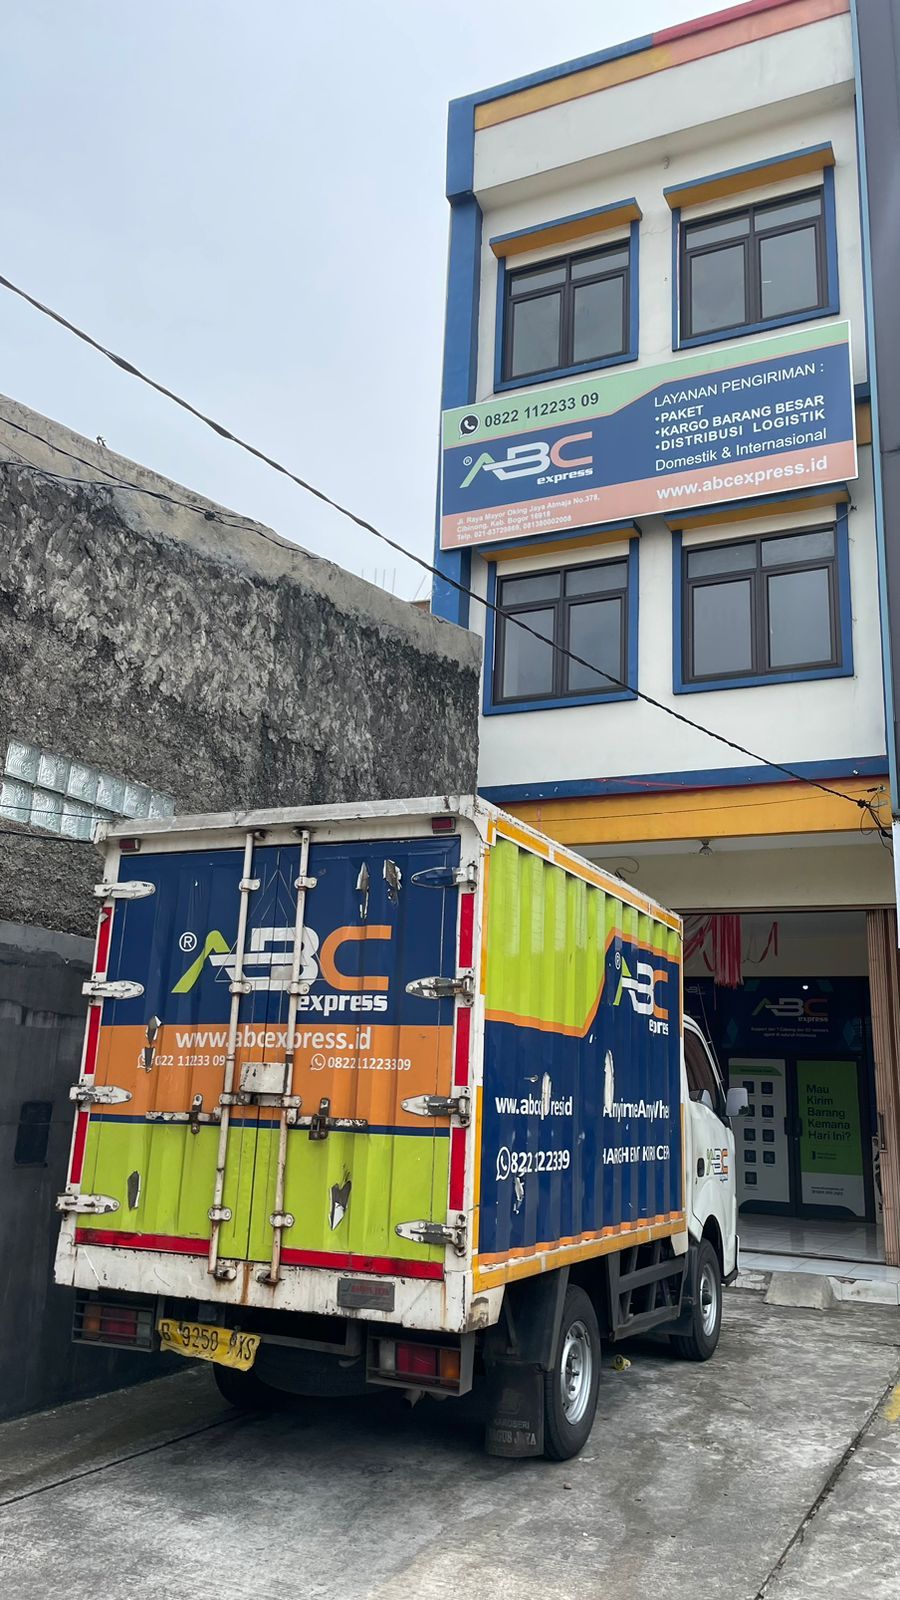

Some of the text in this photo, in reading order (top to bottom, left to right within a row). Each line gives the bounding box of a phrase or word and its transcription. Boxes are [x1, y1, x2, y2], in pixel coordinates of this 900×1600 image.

[654, 384, 718, 408] LAYANAN
[722, 362, 815, 394] PENGIRIMAN
[484, 392, 599, 428] 0822 112233 09
[660, 395, 825, 437] KARGO BARANG BESAR
[661, 404, 704, 423] PAKET
[661, 408, 826, 451] DISTRIBUSI LOGISTIK
[460, 431, 593, 489] ABC
[656, 428, 827, 472] Domestik & Internasional
[536, 468, 594, 486] express
[656, 456, 828, 500] www.abcexpress.id
[484, 511, 506, 522] Mayor
[529, 504, 546, 514] Jaya
[508, 514, 529, 526] Bogor
[171, 925, 392, 994] ABC
[612, 956, 669, 1020] ABC
[297, 994, 388, 1016] express
[752, 998, 828, 1016] ABC
[212, 1054, 226, 1066] 09
[806, 1084, 830, 1094] Mau
[806, 1095, 834, 1106] Kirim
[808, 1107, 846, 1120] Barang
[808, 1118, 850, 1130] Kemana
[808, 1130, 852, 1142] Hari Ini?
[182, 1326, 219, 1352] 9250
